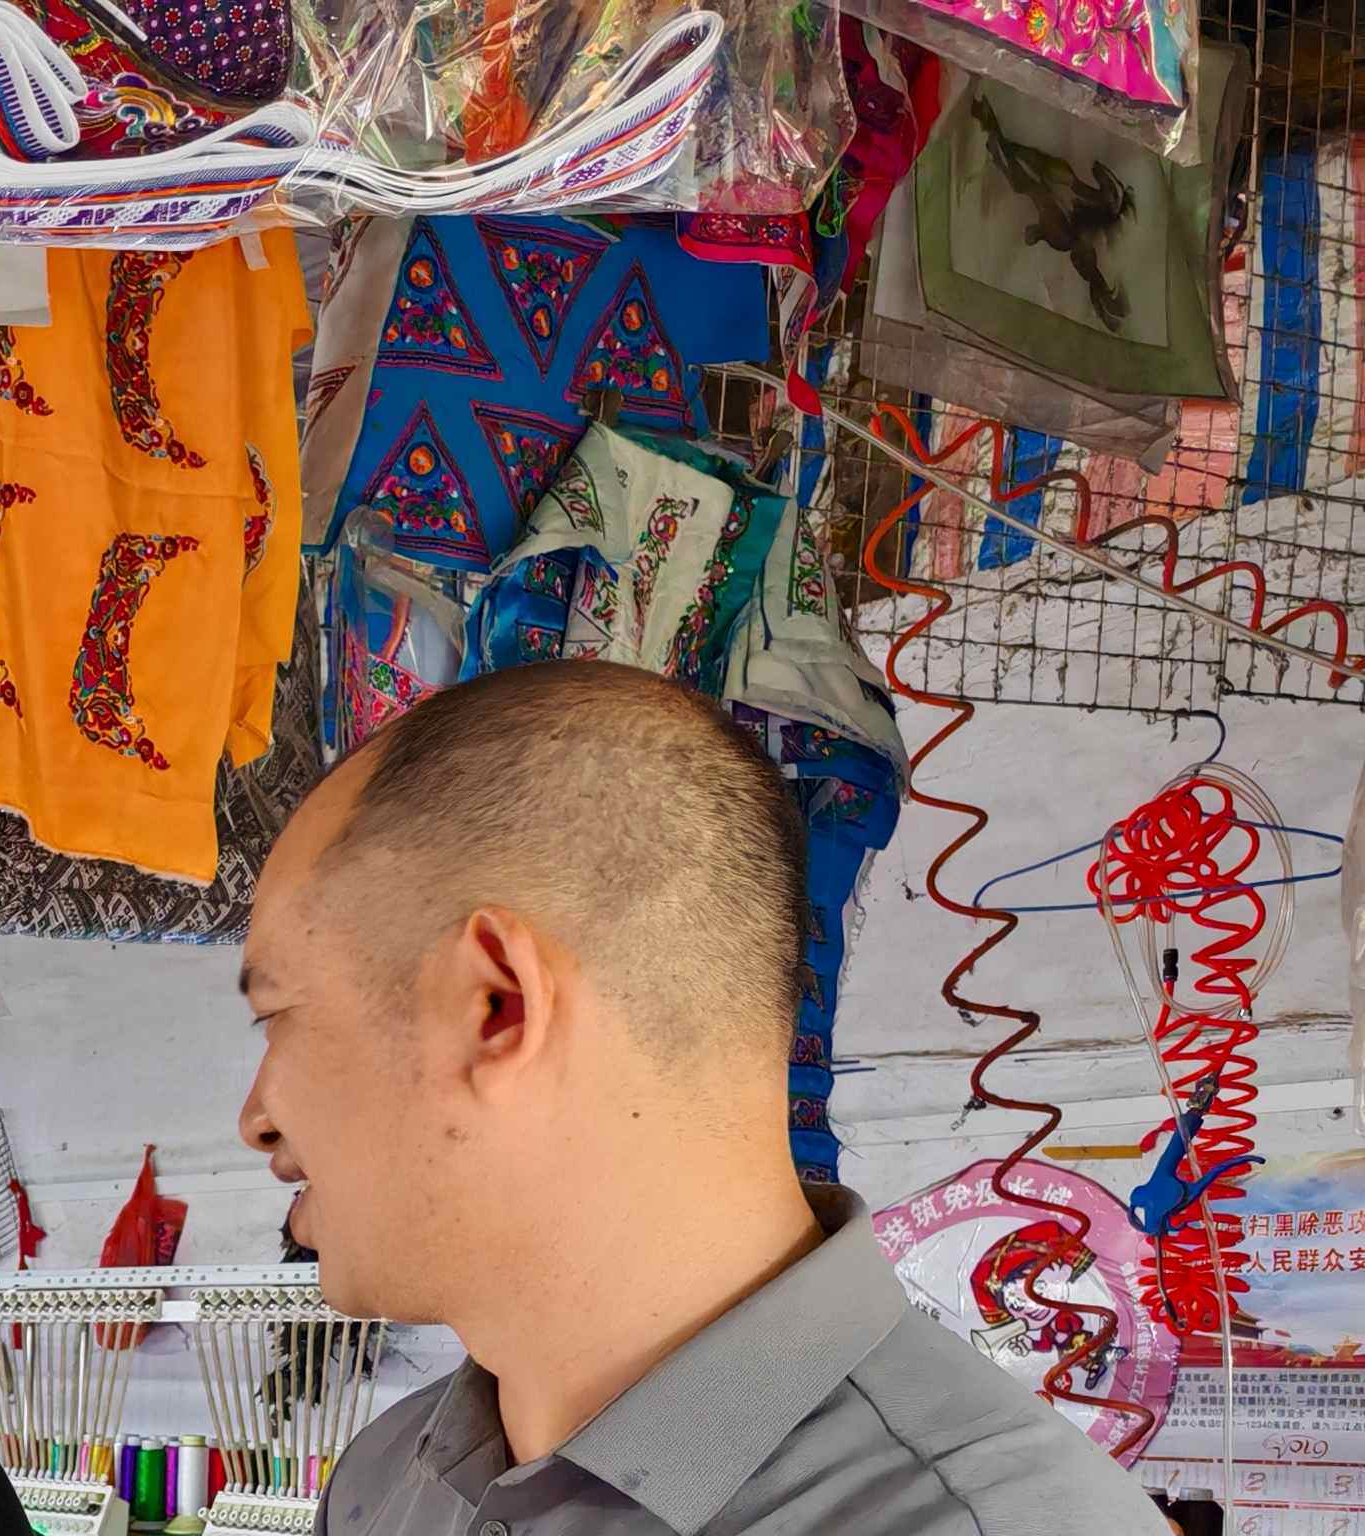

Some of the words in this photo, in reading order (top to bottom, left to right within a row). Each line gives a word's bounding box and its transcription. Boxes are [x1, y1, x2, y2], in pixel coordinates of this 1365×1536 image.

[1241, 1209, 1365, 1237] 扫黑除恶攻
[1237, 1247, 1365, 1274] 人民群众安
[1245, 1472, 1266, 1492] 2
